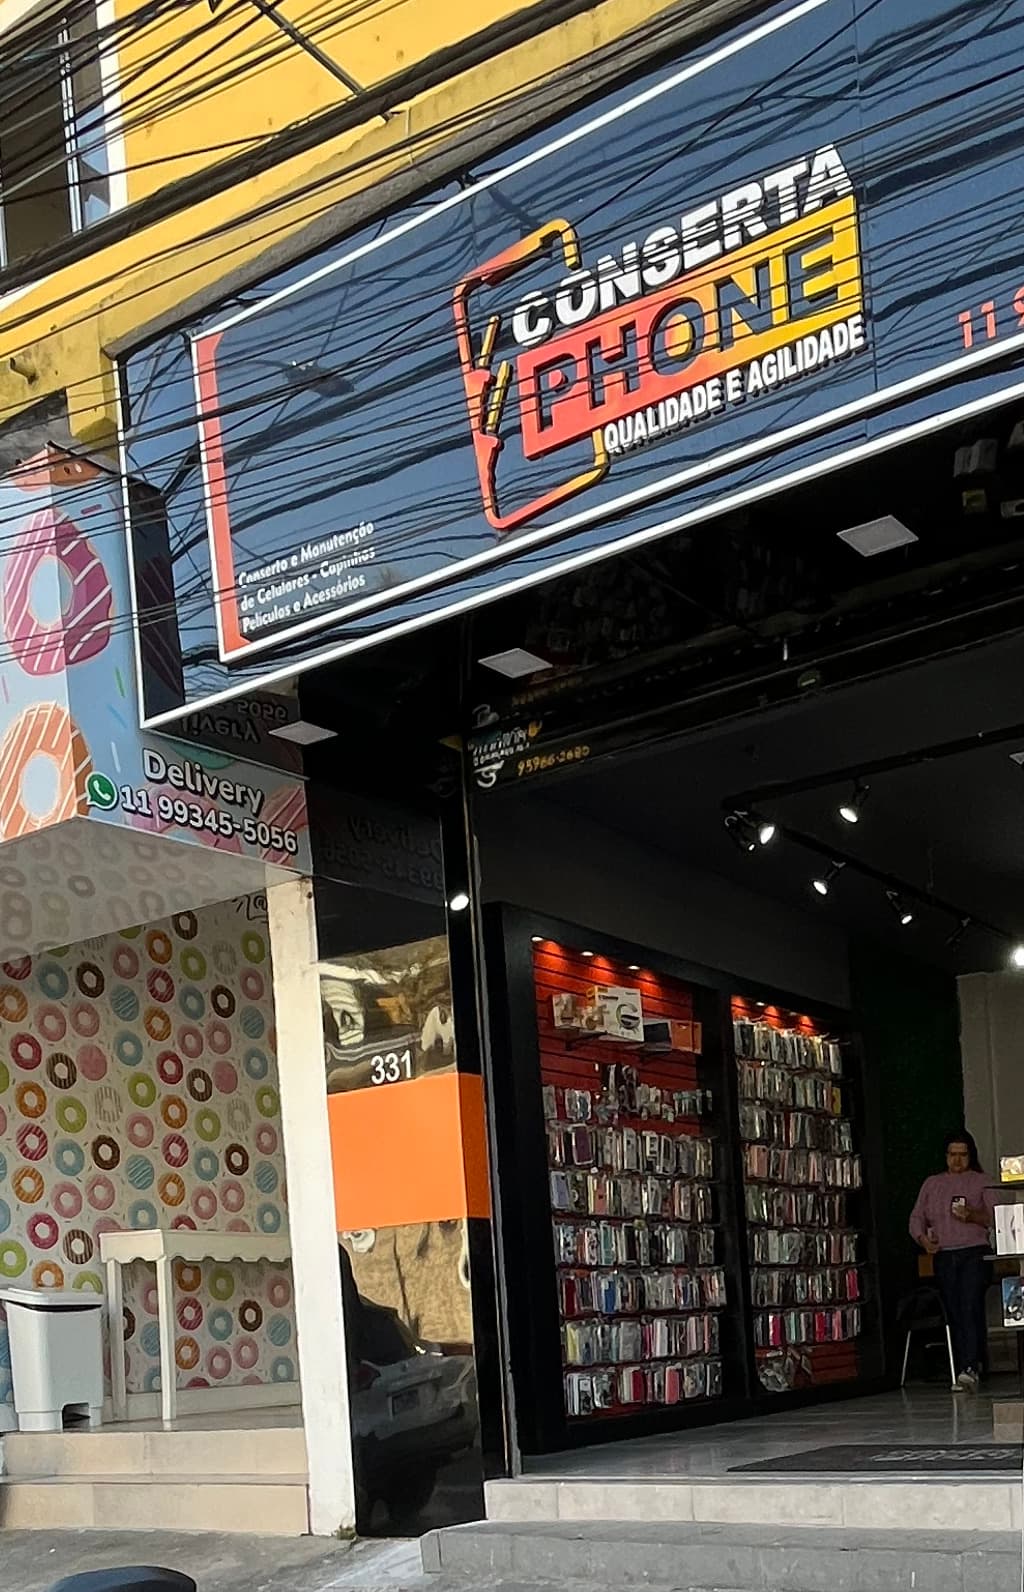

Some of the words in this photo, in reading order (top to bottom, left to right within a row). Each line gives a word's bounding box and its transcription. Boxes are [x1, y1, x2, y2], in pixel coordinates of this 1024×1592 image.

[513, 144, 854, 346] CONSERTA
[534, 227, 841, 433] PHONE
[958, 301, 997, 348] 11
[603, 381, 722, 452] QUALIDADE
[727, 370, 743, 402] E
[748, 315, 866, 396] AGILIDADE
[238, 557, 288, 589] Conserto
[291, 554, 298, 567] e
[301, 521, 374, 563] Manutenção
[240, 595, 254, 611] de
[257, 573, 310, 603] Celulares
[293, 601, 300, 612] e
[303, 574, 365, 609] Acessórios
[143, 749, 265, 814] Delivery
[121, 785, 151, 816] 11
[159, 796, 299, 853] 99345-5056
[371, 1049, 412, 1085] 331
